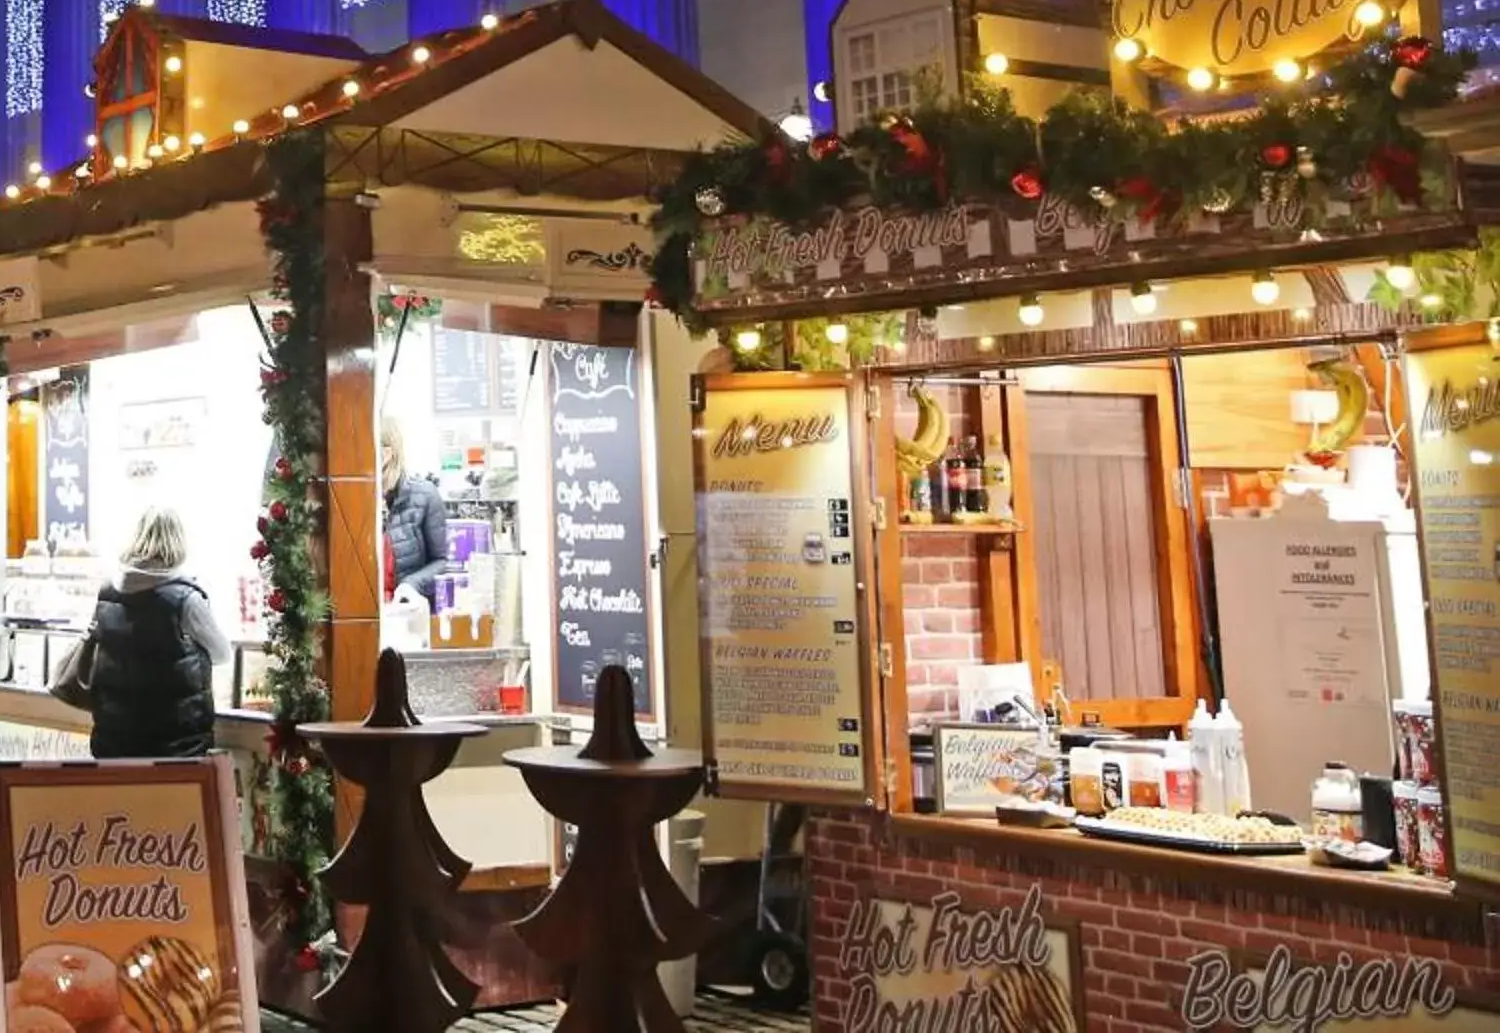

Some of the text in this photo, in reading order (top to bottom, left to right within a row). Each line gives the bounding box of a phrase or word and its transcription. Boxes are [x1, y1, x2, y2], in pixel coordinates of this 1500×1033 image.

[709, 228, 758, 275] Hot
[764, 208, 848, 271] Fresh
[853, 202, 969, 258] Donuts
[711, 413, 839, 460] Menu
[16, 814, 206, 878] Hot Fresh
[43, 872, 187, 929] Donuts
[841, 882, 1052, 976] Hot Fresh
[844, 971, 1001, 1033] Donuts
[1181, 944, 1455, 1033] Belgian
